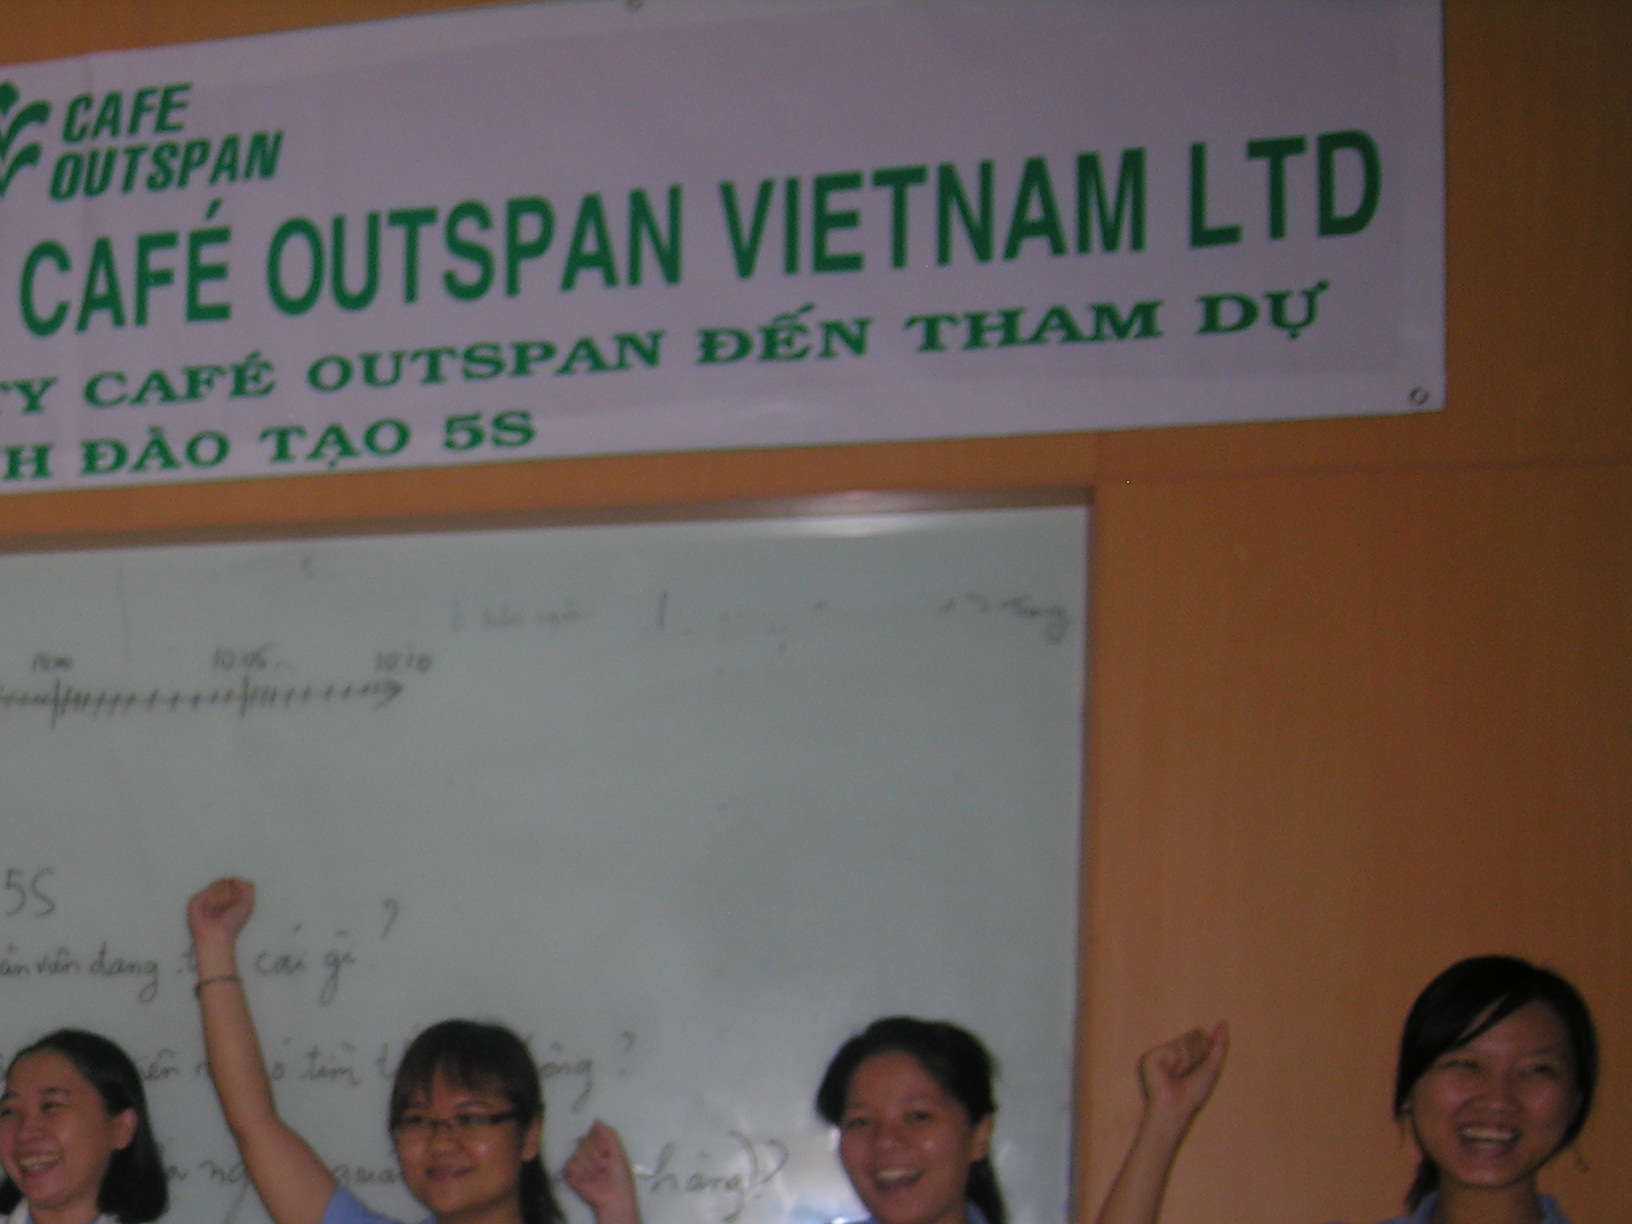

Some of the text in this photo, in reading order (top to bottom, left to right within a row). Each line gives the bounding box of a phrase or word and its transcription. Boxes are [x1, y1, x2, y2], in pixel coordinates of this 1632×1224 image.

[61, 83, 192, 146] CAFE
[48, 130, 285, 203] OUTSPAN
[18, 197, 233, 339] CAFÉ
[265, 182, 683, 318] OUTSPAN
[718, 145, 1149, 280] VIETNAM
[1189, 128, 1384, 250] LTD
[82, 350, 276, 409] CAFÉ
[306, 330, 664, 393] OUTSPAN
[697, 301, 874, 366] ĐẾN
[904, 299, 1164, 353] THAM
[1198, 279, 1331, 340] DỰ
[80, 428, 232, 476] ĐÀO
[259, 417, 412, 469] TẠO
[442, 410, 537, 452] 5S
[5, 867, 57, 919] 5S
